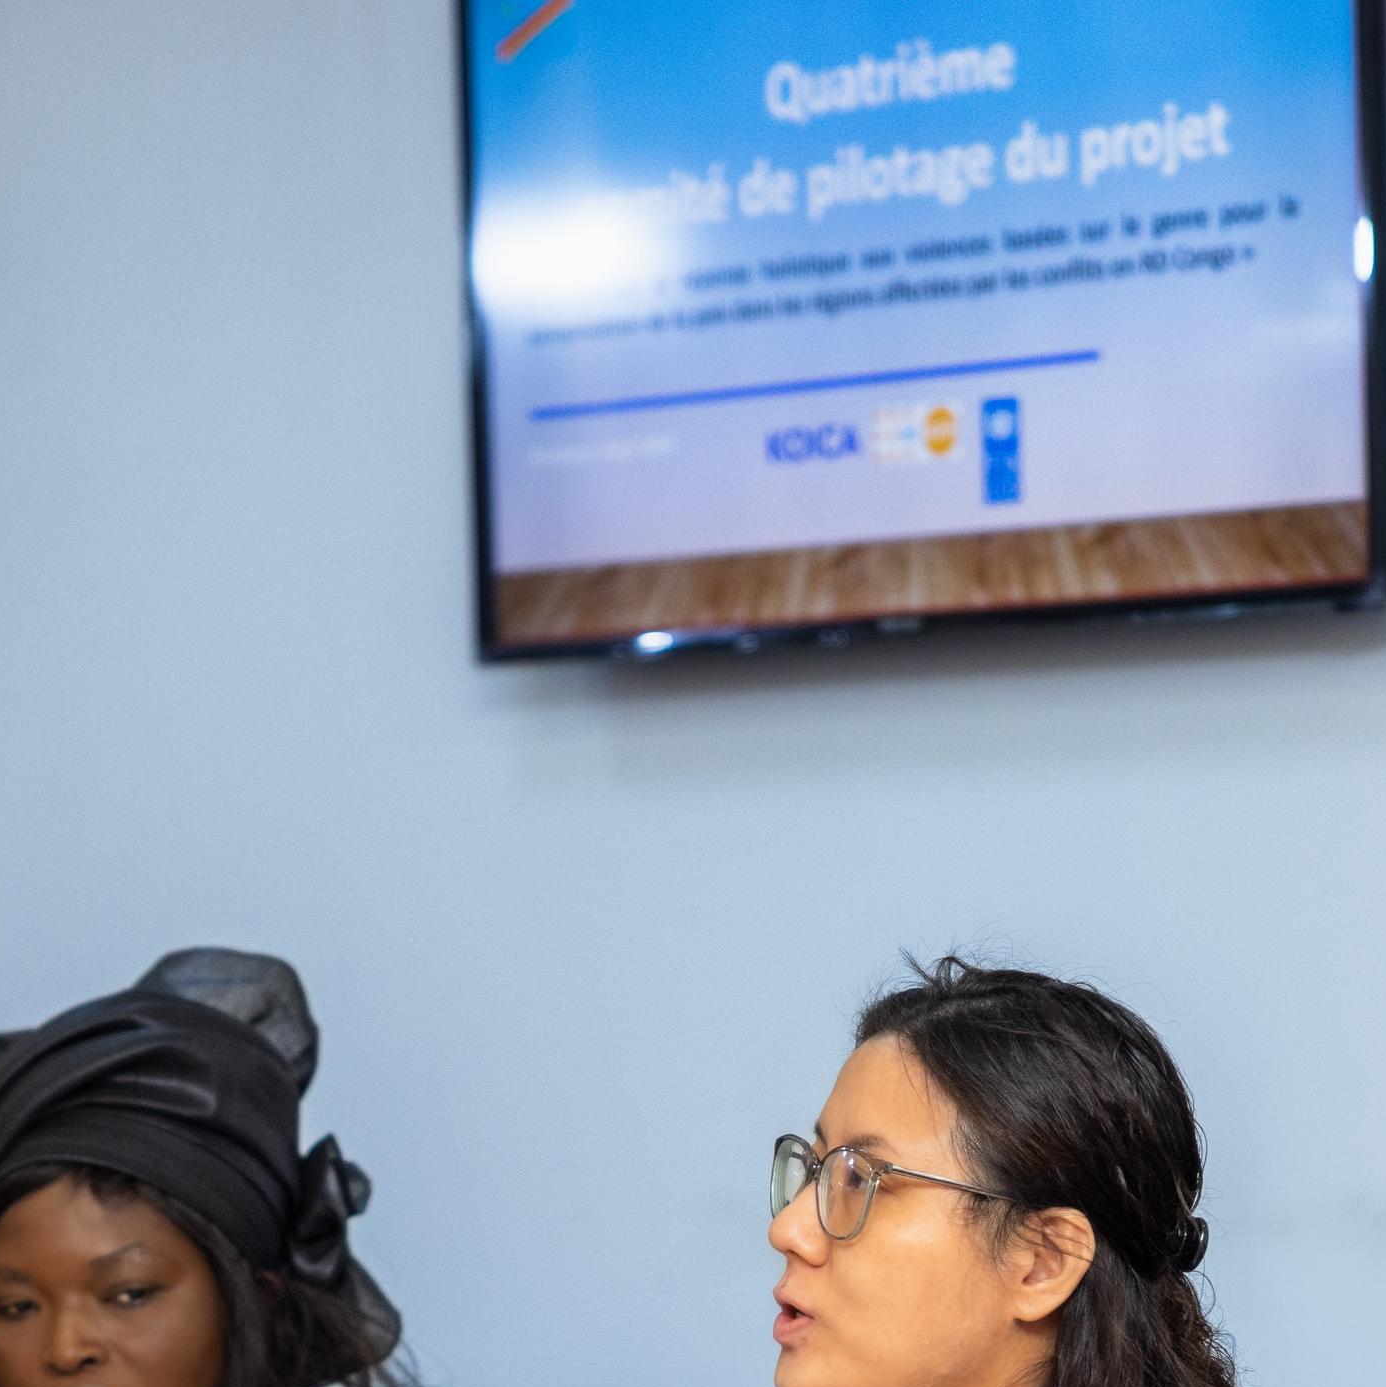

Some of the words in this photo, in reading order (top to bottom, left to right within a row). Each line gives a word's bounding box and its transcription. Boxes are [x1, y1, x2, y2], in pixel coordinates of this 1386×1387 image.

[764, 39, 1015, 124] Quatrième
[738, 158, 798, 218] de
[807, 145, 995, 222] pilotage
[1005, 121, 1069, 183] du
[1080, 102, 1231, 188] projet
[763, 422, 861, 464] KOICA
